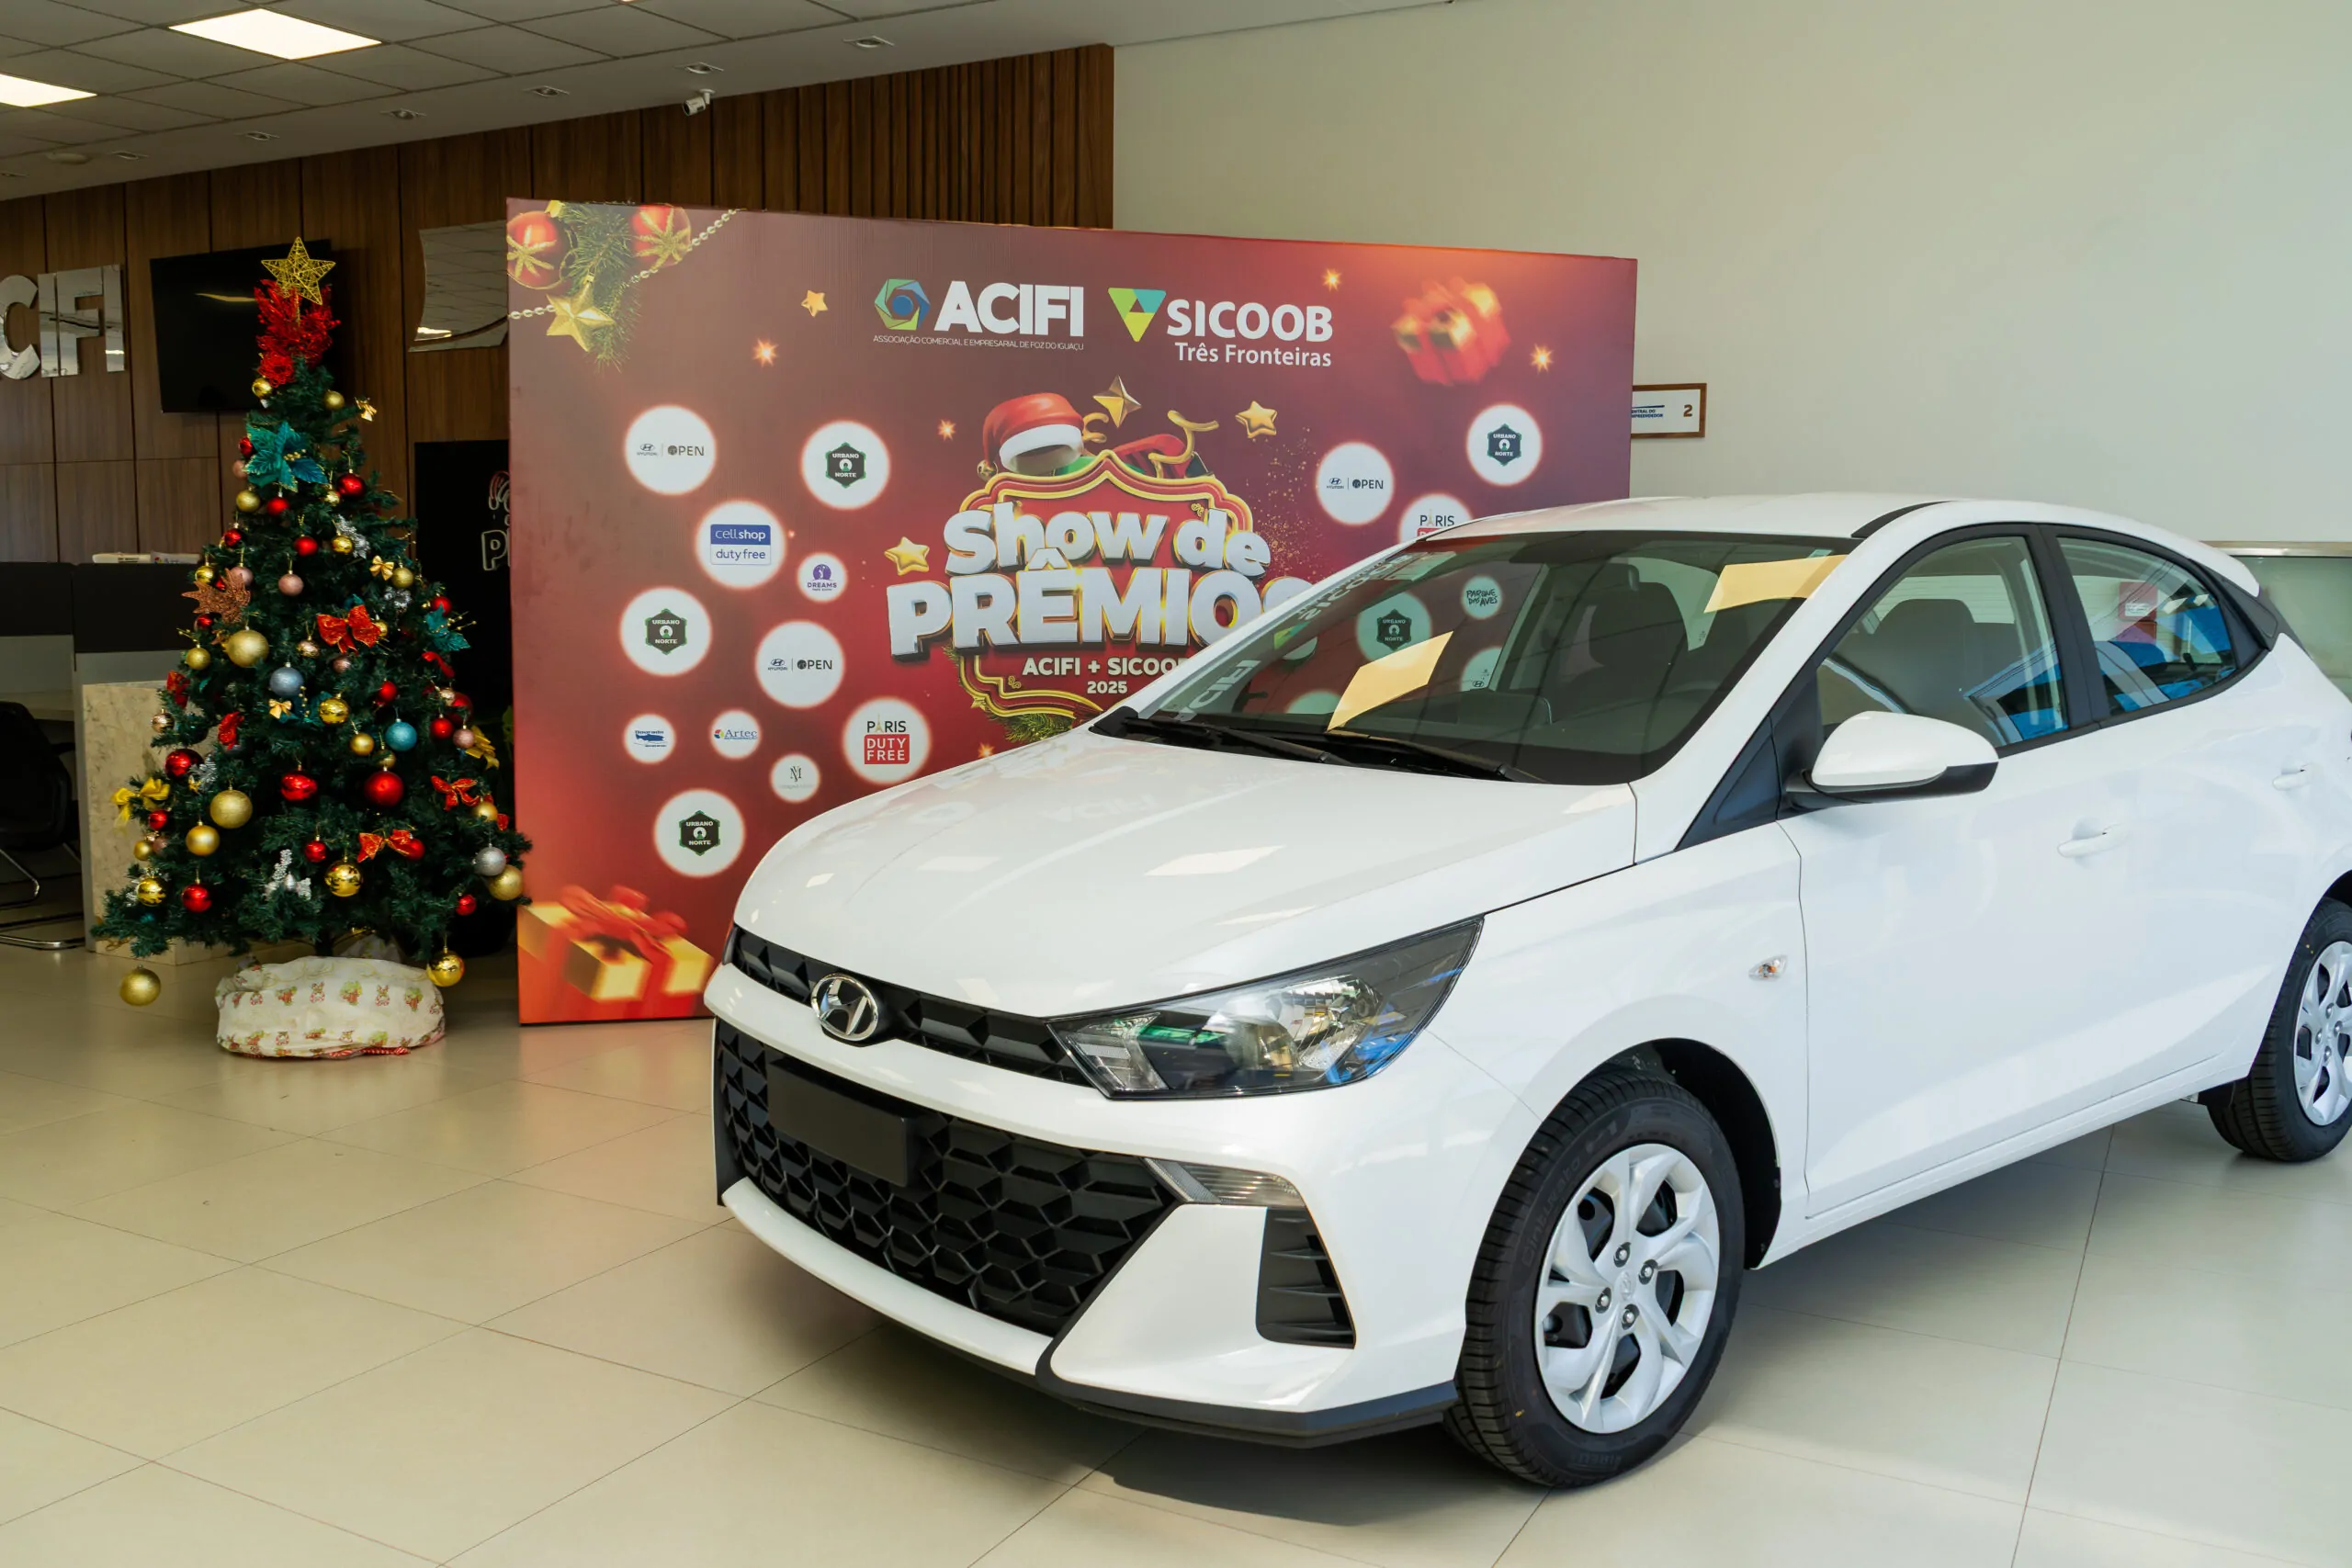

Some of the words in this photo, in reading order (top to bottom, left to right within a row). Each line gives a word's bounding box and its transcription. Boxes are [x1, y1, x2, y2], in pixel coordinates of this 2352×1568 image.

[933, 280, 1084, 337] ACIFI
[1167, 299, 1333, 343] SICOOB
[873, 334, 921, 345] ASSOCIAÇÃO
[922, 336, 962, 345] COMERCIAL
[969, 339, 1019, 348] EMPRESARIAL
[1030, 341, 1046, 349] FOZ
[1046, 342, 1057, 350] DO
[1057, 343, 1084, 352] IGUAÇU
[1175, 342, 1219, 363] Três
[1226, 344, 1331, 367] Fronteiras
[1683, 404, 1693, 417] 2
[1419, 511, 1455, 526] PARIS
[1172, 509, 1272, 575] de
[716, 548, 742, 561] duty
[742, 548, 766, 559] free
[1023, 657, 1080, 676] ACIFI
[1087, 681, 1128, 694] 2025
[866, 716, 907, 733] PARIS
[866, 738, 907, 750] DUTY
[866, 750, 906, 761] FREE
